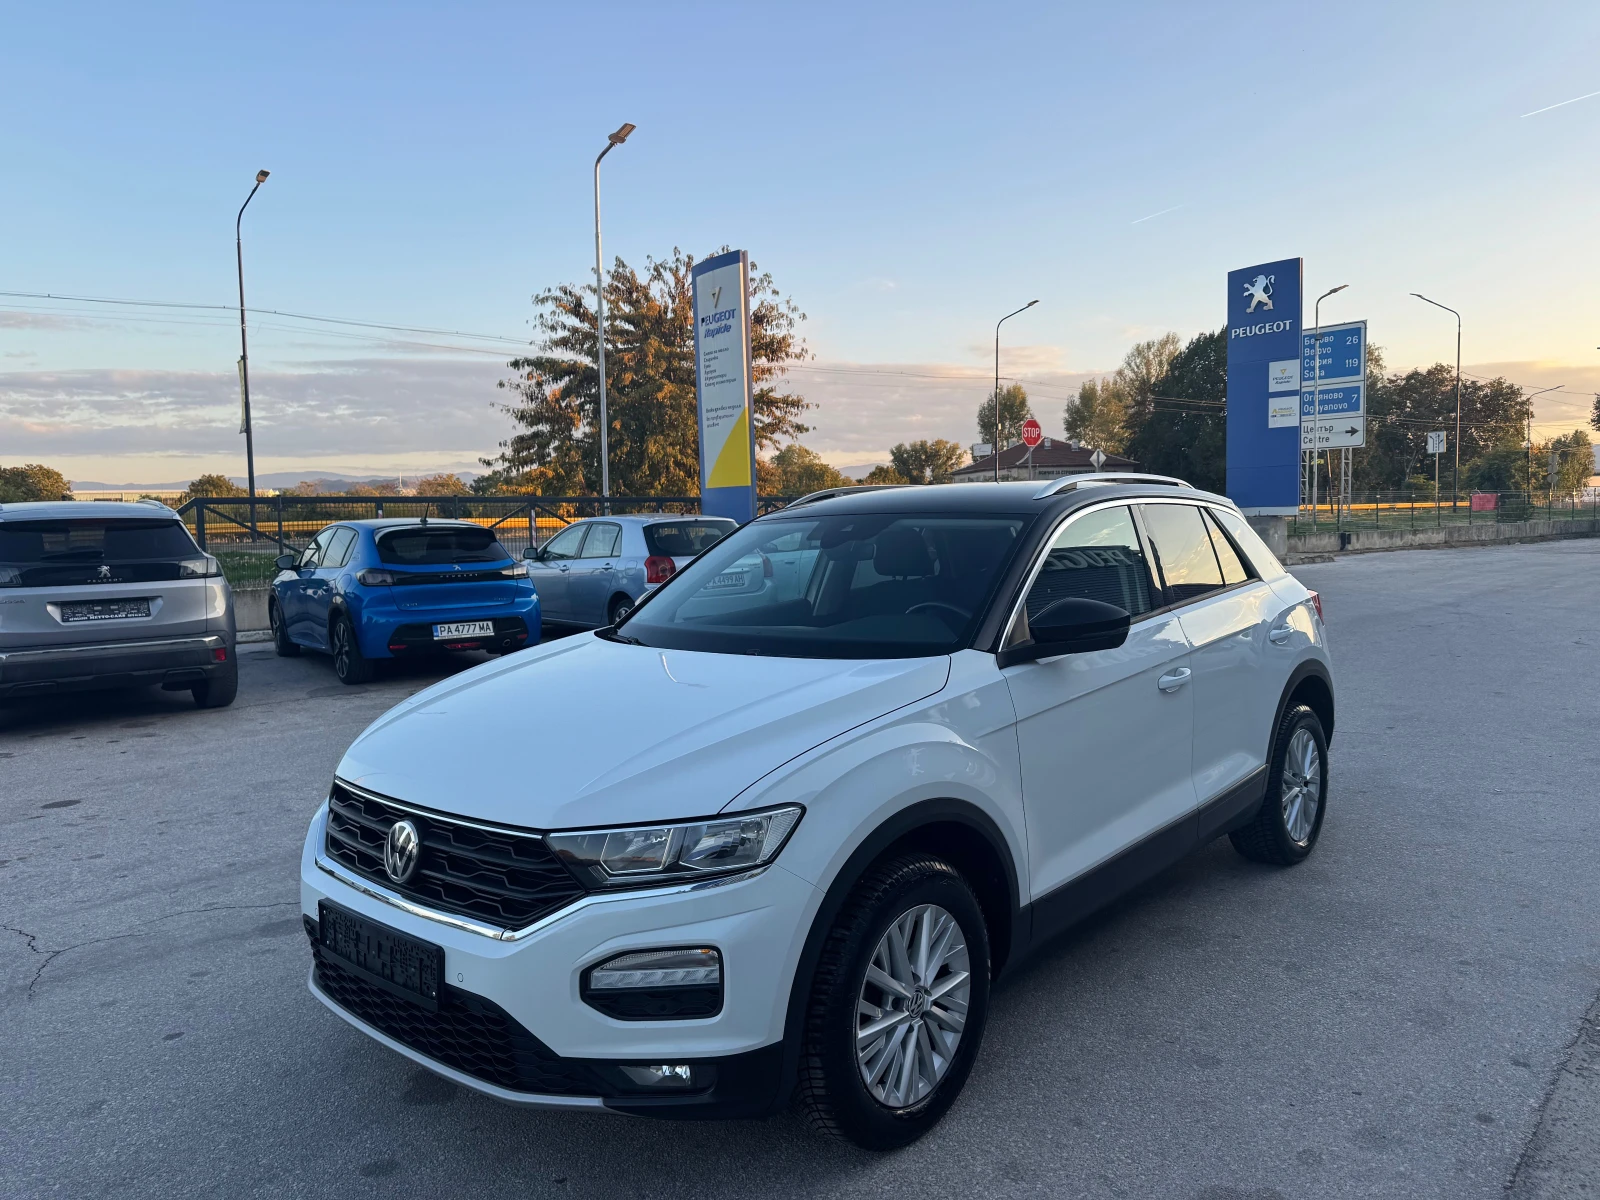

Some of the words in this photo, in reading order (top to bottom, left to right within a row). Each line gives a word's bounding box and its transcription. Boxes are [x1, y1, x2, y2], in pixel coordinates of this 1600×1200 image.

[701, 308, 736, 327] PEUGEOT
[1231, 319, 1293, 339] PEUGEOT
[1304, 335, 1334, 345] Беово
[1346, 335, 1359, 345] 26
[1304, 347, 1332, 356] Beovo
[1345, 358, 1359, 367] 119
[1304, 370, 1325, 378] Soia
[1303, 392, 1343, 402] Огяново
[1351, 394, 1358, 403] 7
[1303, 403, 1348, 414] Ogyanovo
[1024, 427, 1040, 438] STOP
[1303, 425, 1334, 434] Цетър
[1303, 436, 1330, 444] Cetre
[718, 576, 733, 585] 4499
[439, 625, 453, 636] PA
[454, 623, 477, 634] 4777
[478, 622, 491, 633] MA
